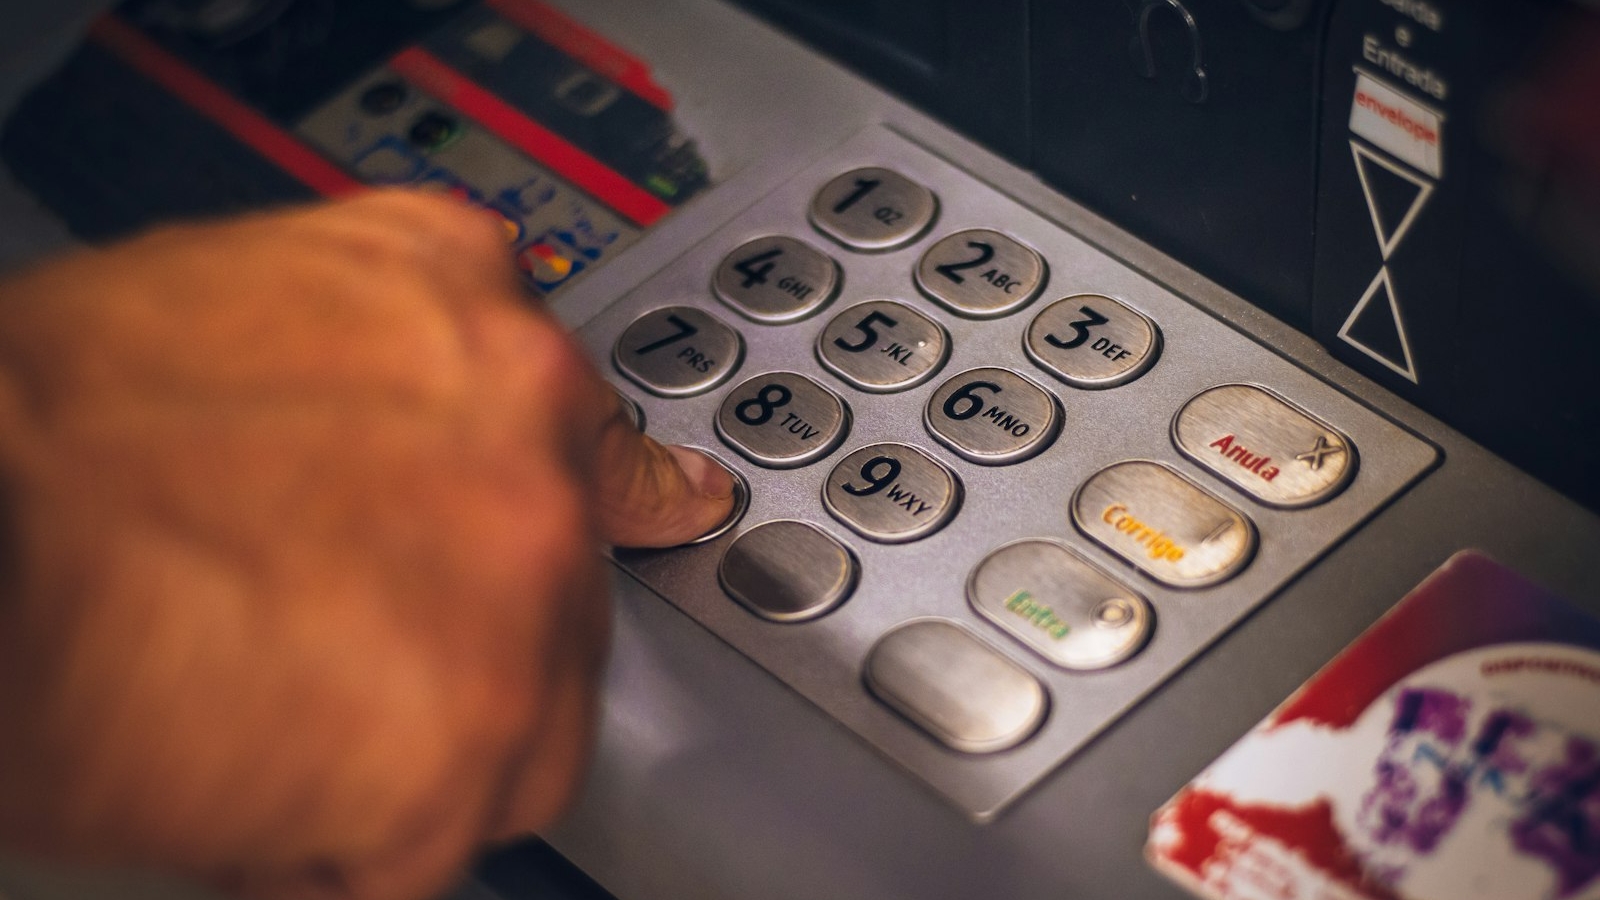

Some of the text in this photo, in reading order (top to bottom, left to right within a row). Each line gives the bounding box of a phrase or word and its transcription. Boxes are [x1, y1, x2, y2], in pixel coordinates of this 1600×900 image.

[1395, 26, 1411, 47] e
[1363, 35, 1447, 99] Entrada
[1355, 91, 1437, 145] envelope
[833, 178, 881, 214] 1
[734, 247, 815, 300] 4 GHI
[934, 241, 1022, 294] 2 ABC
[636, 314, 715, 374] 7 PRS
[833, 310, 915, 367] 5 JKL
[1043, 306, 1132, 363] 3 DEF
[735, 384, 820, 441] 8 TUV
[943, 380, 1030, 437] 6 MNO
[841, 455, 932, 517] 9 WXY
[1209, 434, 1280, 483] Anula
[1102, 502, 1185, 562] Corrige
[1003, 588, 1070, 639] Entra
